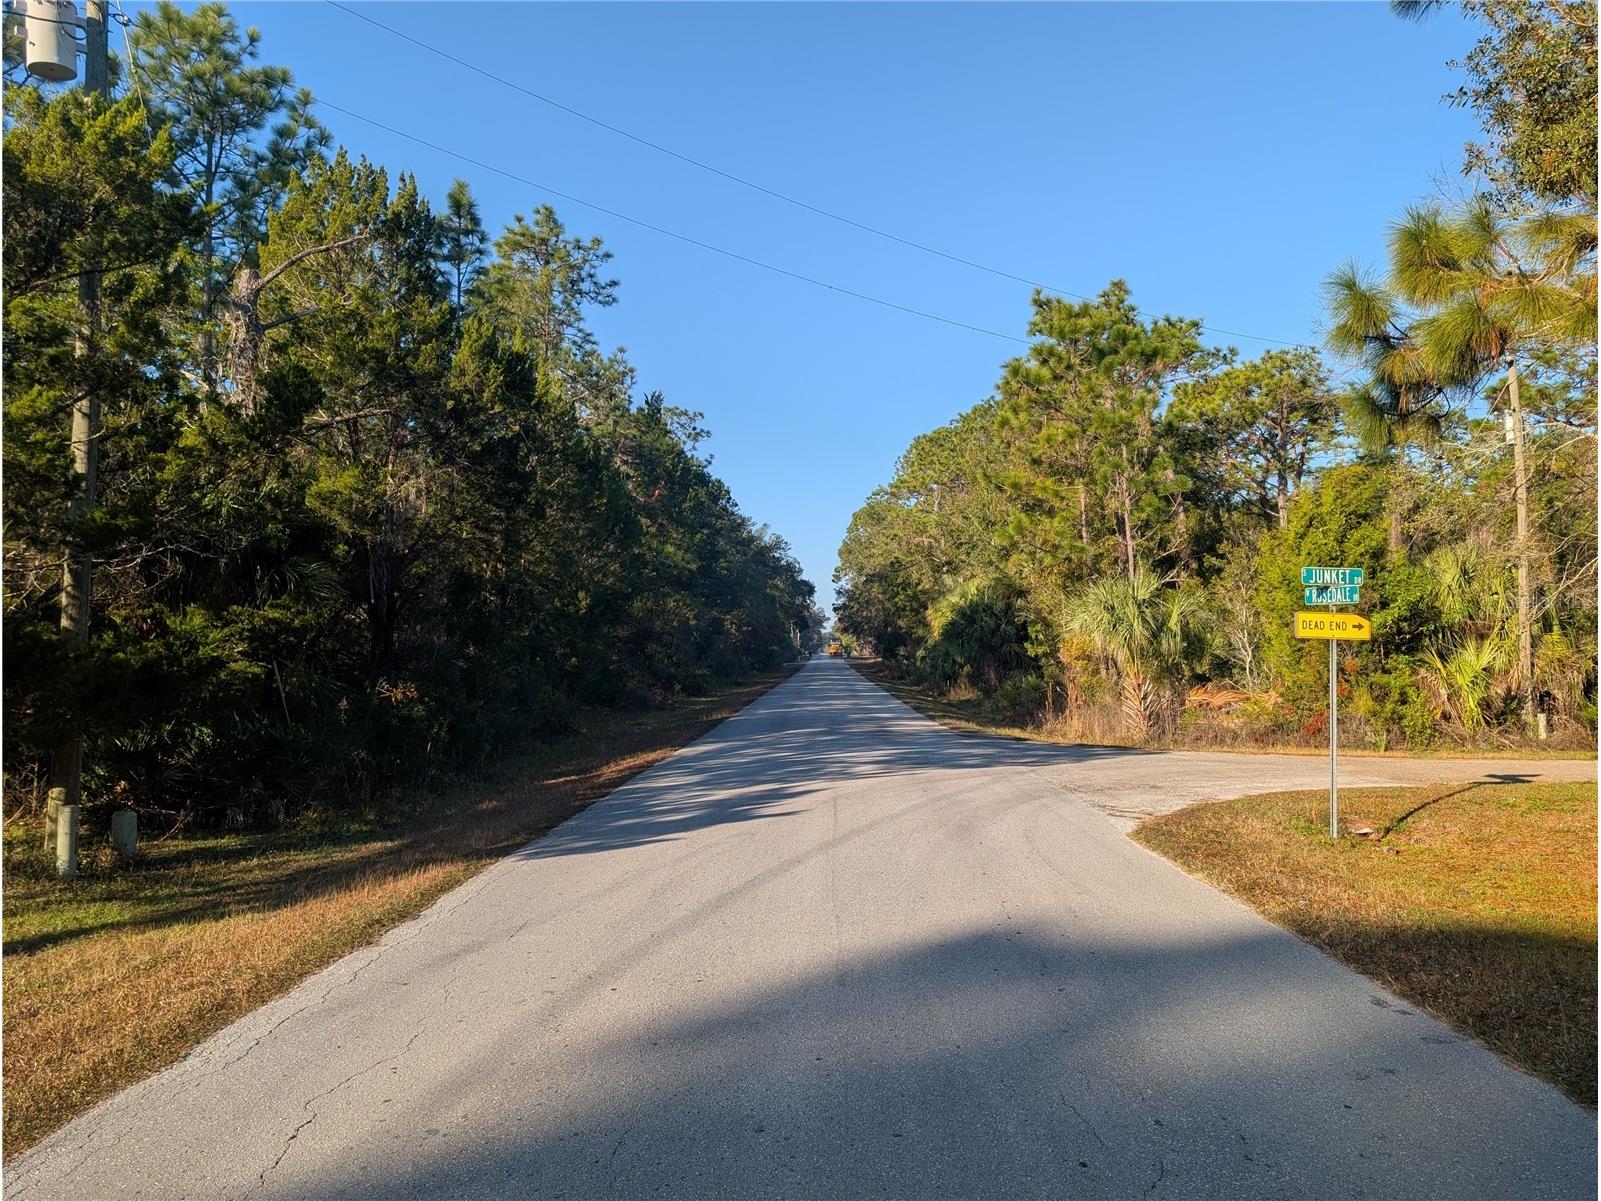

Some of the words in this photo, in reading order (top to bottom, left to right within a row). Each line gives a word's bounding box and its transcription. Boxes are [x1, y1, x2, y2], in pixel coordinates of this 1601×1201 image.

[1309, 569, 1350, 584] JUNKET
[1312, 587, 1350, 603] ROSEDALE
[1302, 620, 1325, 630] DEAD
[1329, 621, 1347, 631] END
